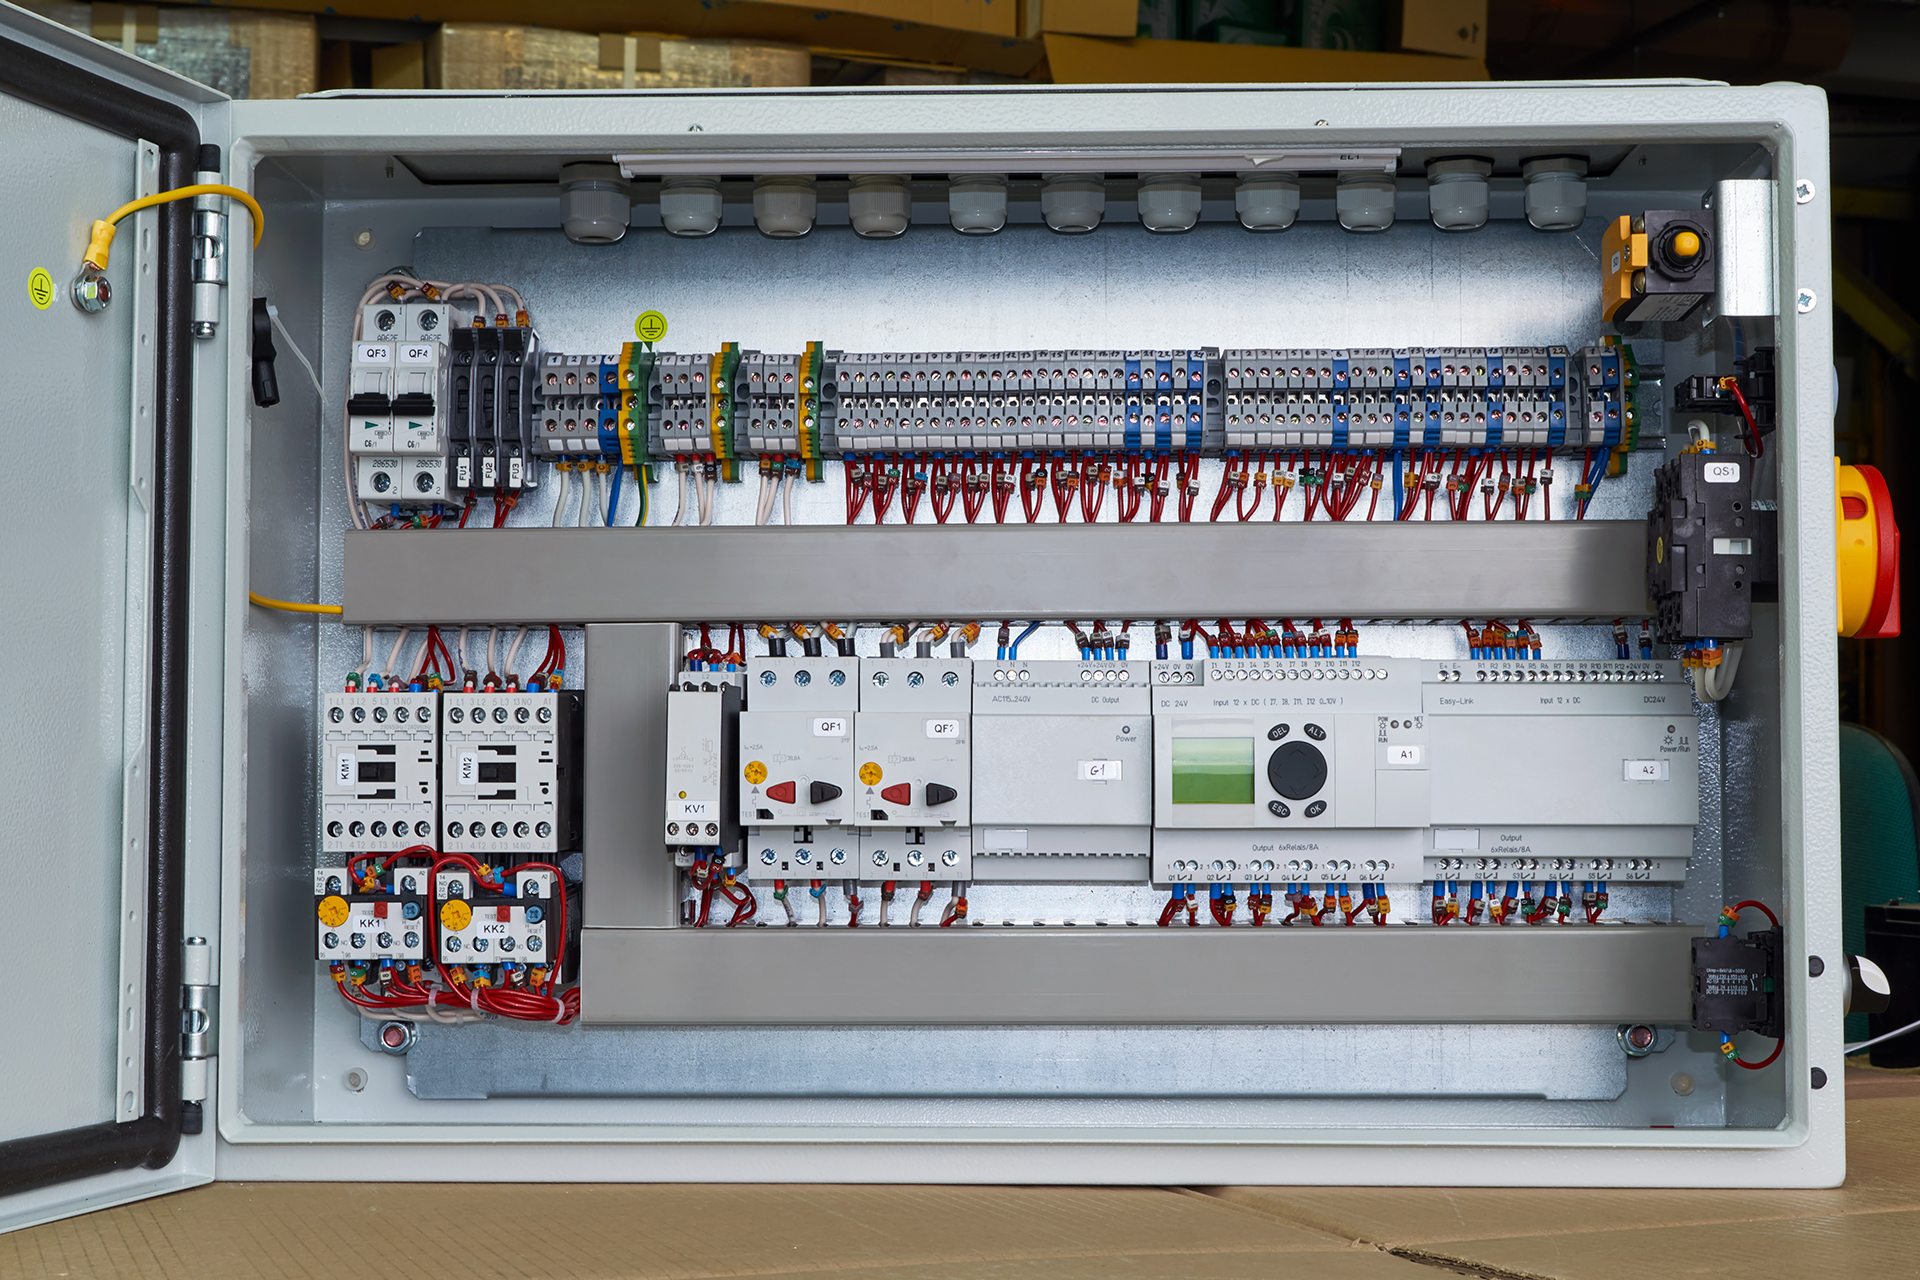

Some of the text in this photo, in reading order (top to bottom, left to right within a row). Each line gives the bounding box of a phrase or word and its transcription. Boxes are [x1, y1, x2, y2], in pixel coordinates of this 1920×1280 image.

[367, 349, 386, 358] QF3
[409, 349, 428, 358] QF4
[1713, 467, 1735, 476] QS1
[1540, 697, 1553, 705] Input
[821, 723, 841, 731] QF1
[1272, 726, 1287, 738] DEL
[1308, 726, 1324, 738] ALT
[341, 758, 349, 779] KM1
[463, 757, 472, 778] KM2
[685, 805, 705, 813] KV1
[1272, 803, 1287, 816] ESC
[1310, 805, 1322, 815] OK
[484, 925, 505, 933] KK2
